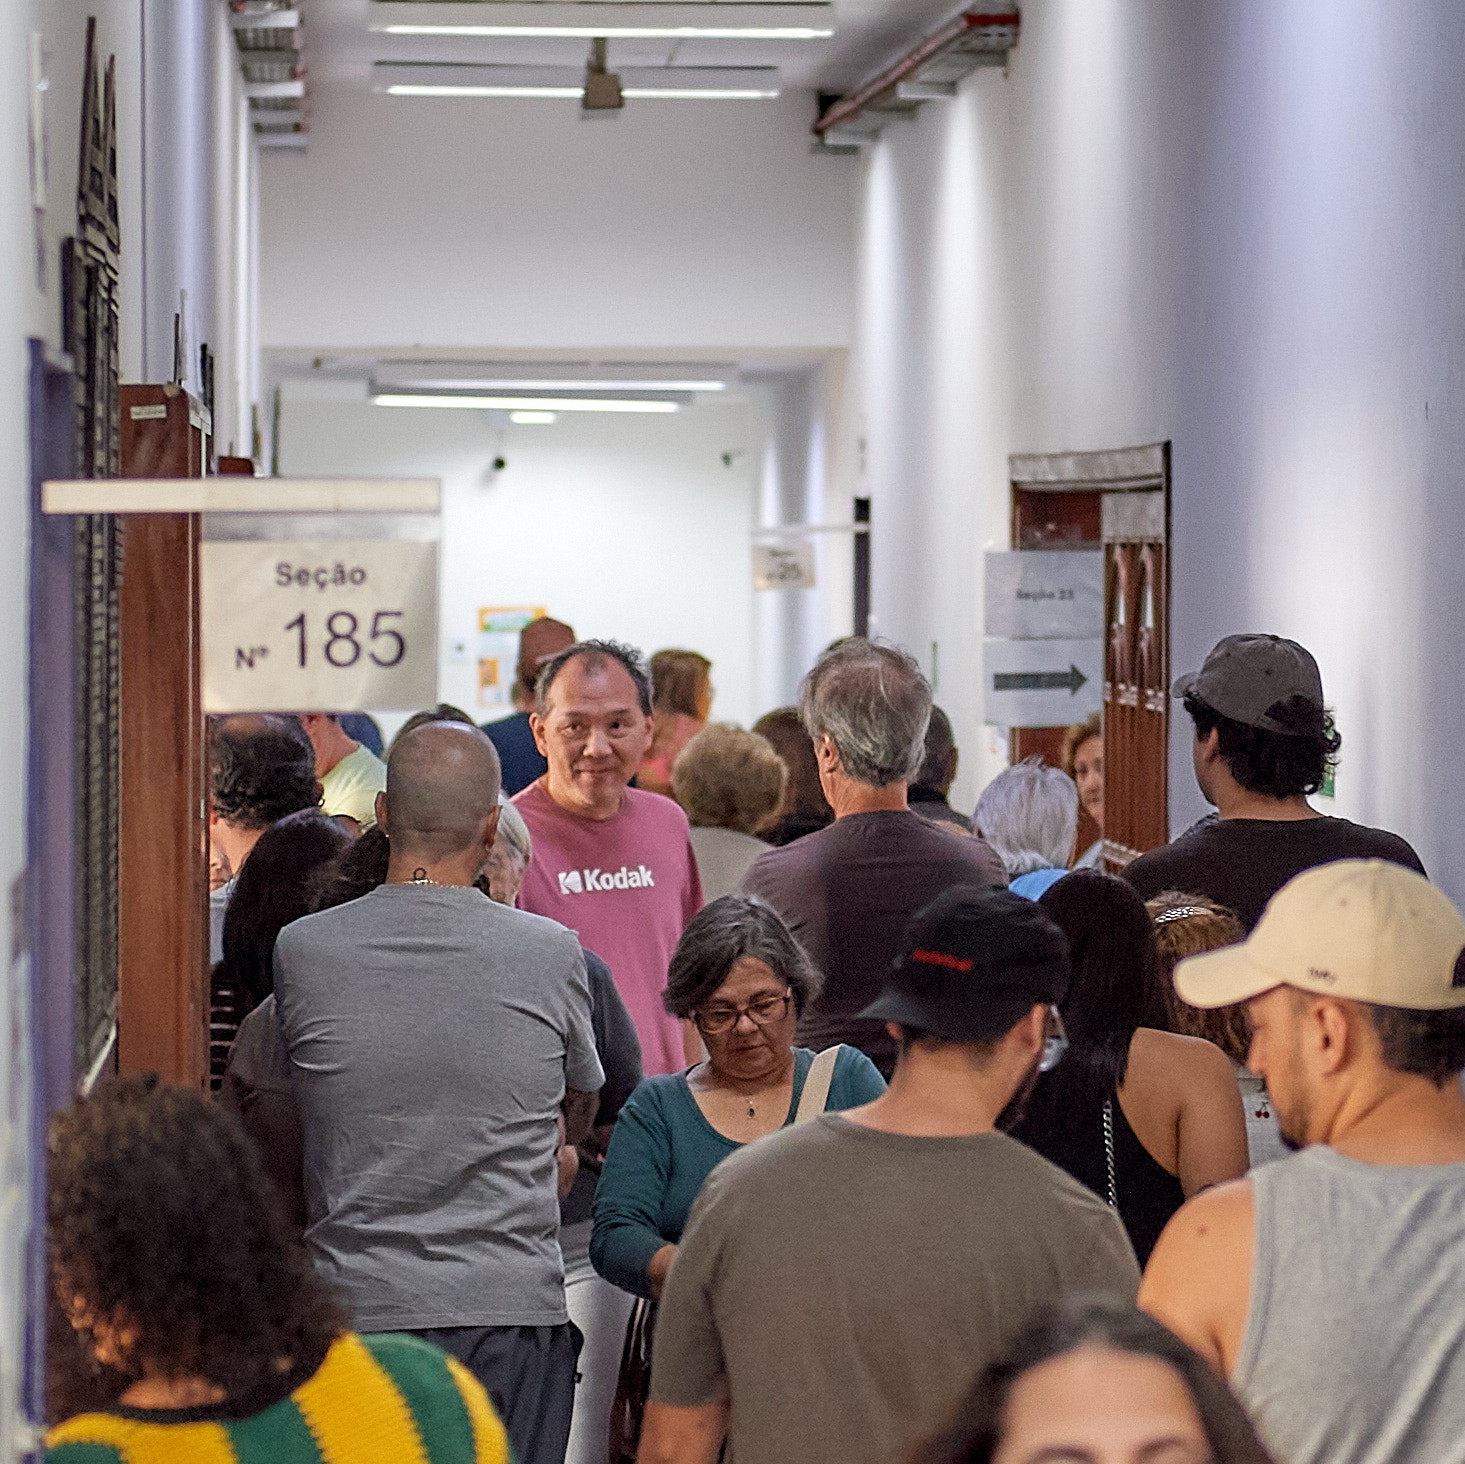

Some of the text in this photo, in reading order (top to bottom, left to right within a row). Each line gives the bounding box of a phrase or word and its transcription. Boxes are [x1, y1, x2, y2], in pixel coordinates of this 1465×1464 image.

[276, 562, 367, 590] Seção
[285, 611, 406, 668] 185
[582, 864, 655, 891] Kodak
